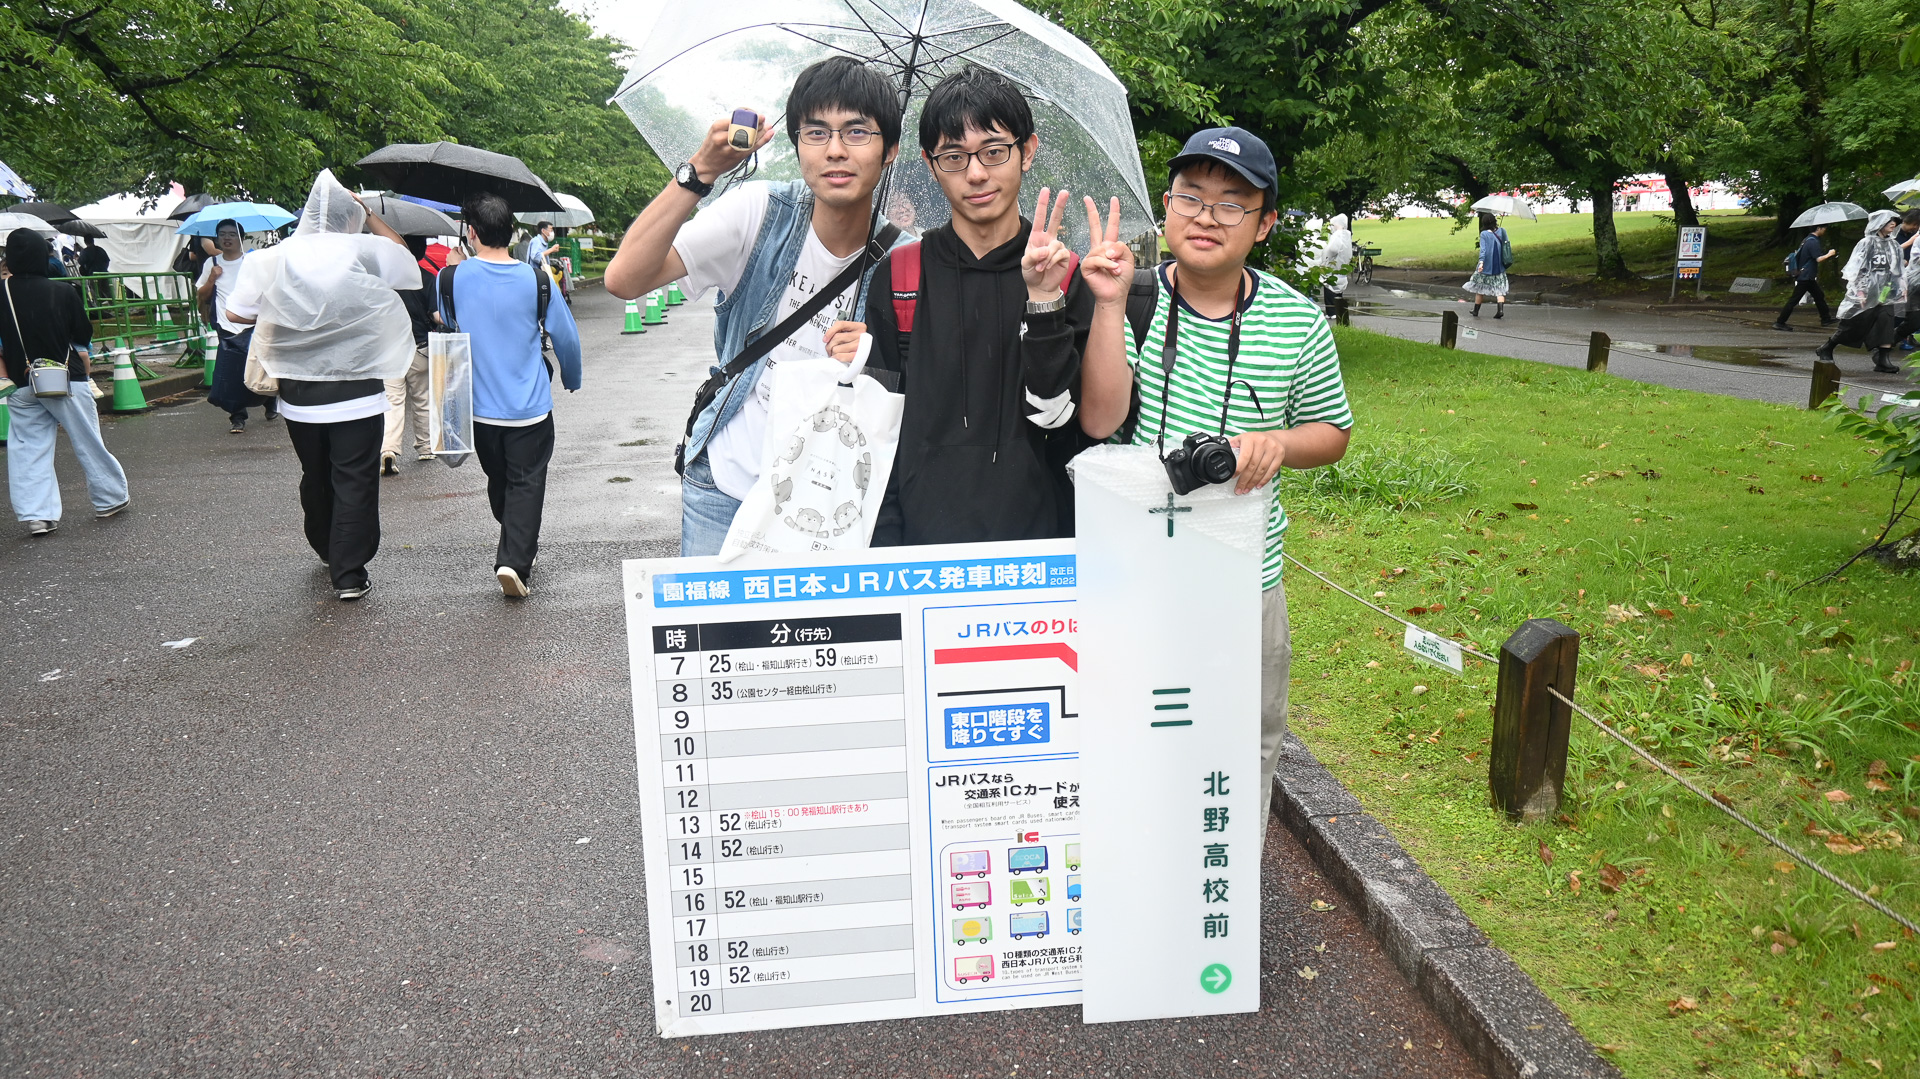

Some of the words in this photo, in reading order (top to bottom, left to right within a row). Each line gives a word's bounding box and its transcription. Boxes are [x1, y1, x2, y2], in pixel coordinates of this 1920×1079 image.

[1873, 254, 1887, 265] 33
[1195, 436, 1210, 444] Canon
[1050, 567, 1074, 575] 改正日
[663, 580, 730, 602] 園福線
[743, 561, 1046, 600] 西日本JRバス発車時刻
[1050, 577, 1075, 585] 2022
[666, 629, 687, 649] 時
[770, 624, 791, 643] 分
[670, 656, 685, 675] 7
[710, 654, 731, 673] 25
[815, 648, 836, 667] 59
[672, 684, 688, 702] 8
[711, 681, 733, 700] 35
[674, 710, 690, 728] 9
[951, 708, 1043, 728] 東口階段を
[952, 724, 1043, 745] 降りてすぐ
[674, 737, 694, 756] 10
[676, 764, 694, 782] 11
[936, 772, 1014, 787] JRバスなら
[677, 790, 698, 808] 12
[679, 816, 700, 834] 13
[720, 813, 741, 831] 52
[681, 842, 701, 860] 14
[721, 839, 742, 857] 52
[1202, 770, 1230, 939] 北野高校前
[683, 868, 703, 886] 15
[685, 894, 705, 911] 16
[724, 890, 746, 908] 52
[686, 919, 706, 937] 17
[688, 944, 708, 962] 18
[727, 941, 748, 958] 52
[690, 969, 710, 987] 19
[729, 966, 750, 984] 52
[690, 994, 712, 1012] 20
